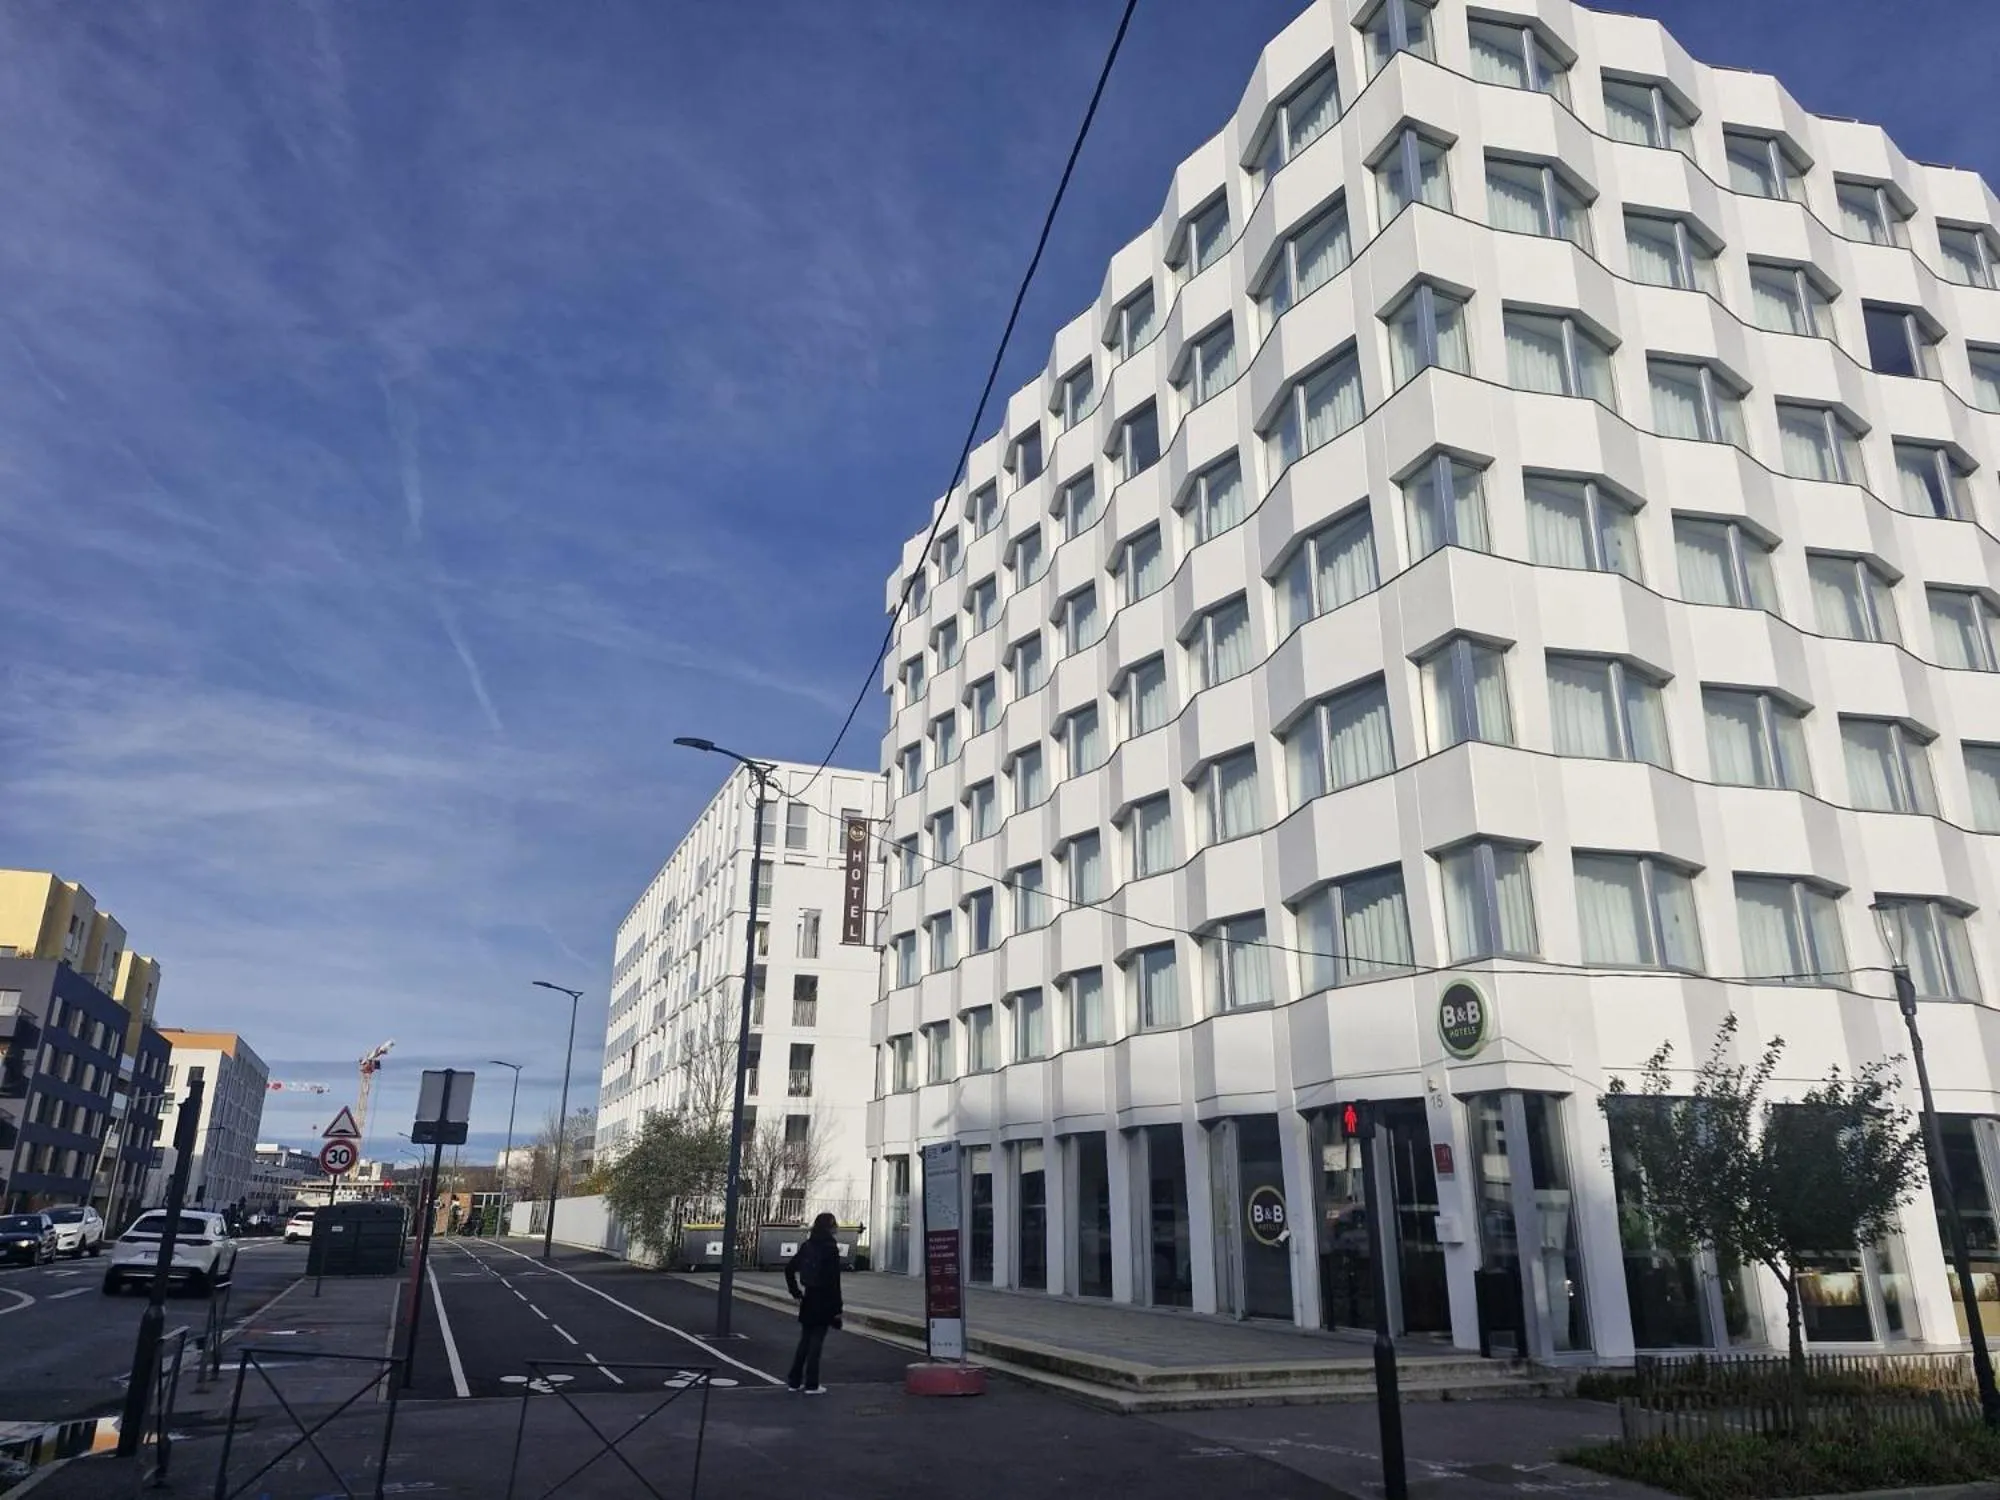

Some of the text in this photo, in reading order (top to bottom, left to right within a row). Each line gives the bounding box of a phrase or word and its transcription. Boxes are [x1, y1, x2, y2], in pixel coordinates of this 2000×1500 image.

[849, 849, 862, 937] HOTEL
[1442, 1000, 1480, 1029] B&B
[1449, 1026, 1477, 1038] HOTELS
[327, 1149, 350, 1165] 30
[1253, 1204, 1284, 1223] B&B
